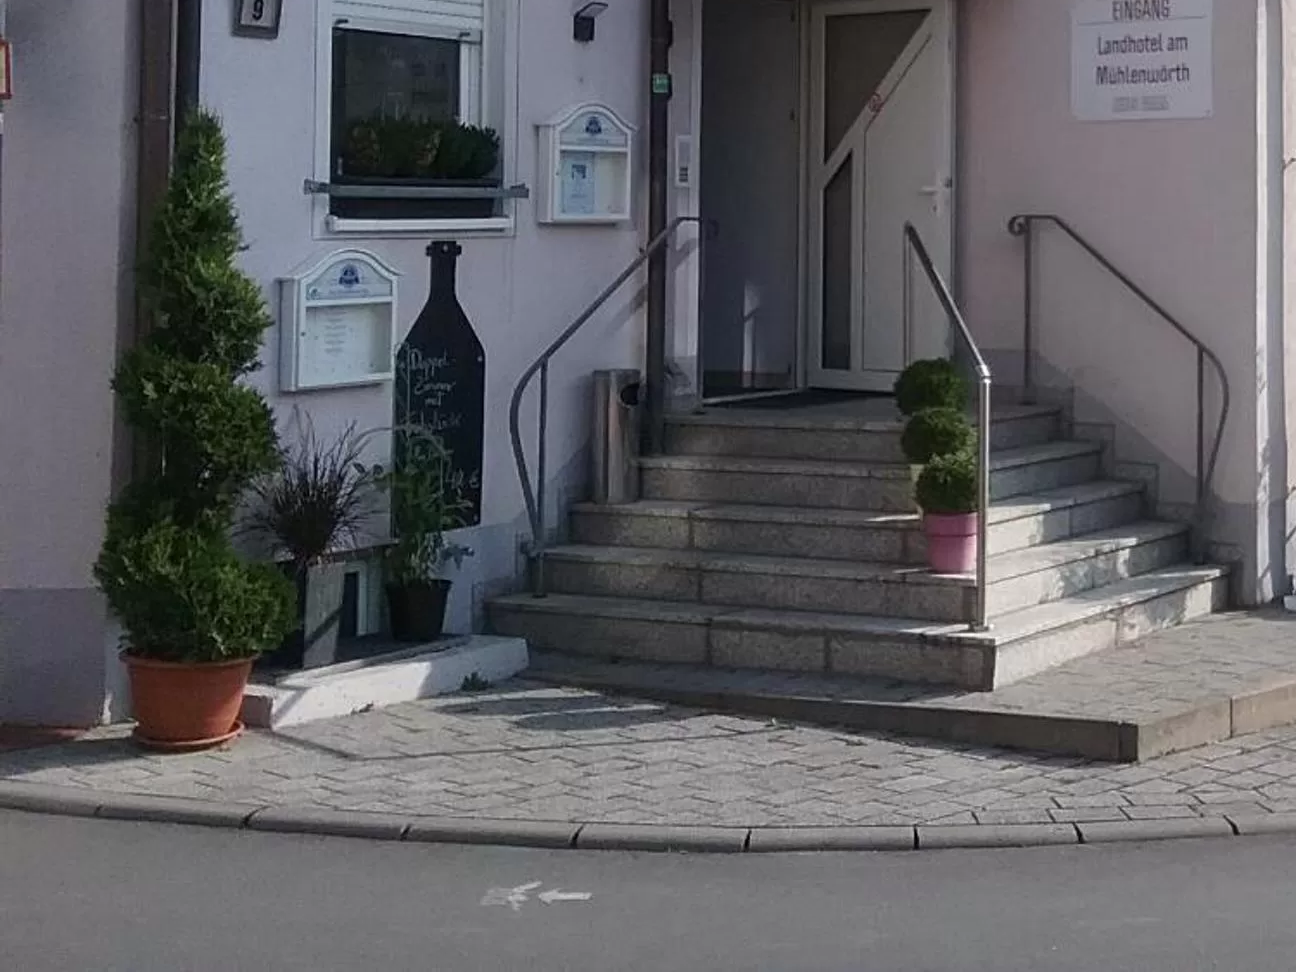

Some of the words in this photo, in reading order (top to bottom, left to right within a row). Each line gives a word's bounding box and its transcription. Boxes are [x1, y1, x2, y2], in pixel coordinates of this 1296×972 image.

[1097, 32, 1164, 56] Landhotel
[1167, 36, 1188, 52] am
[1096, 62, 1190, 85] Mühlenwörth
